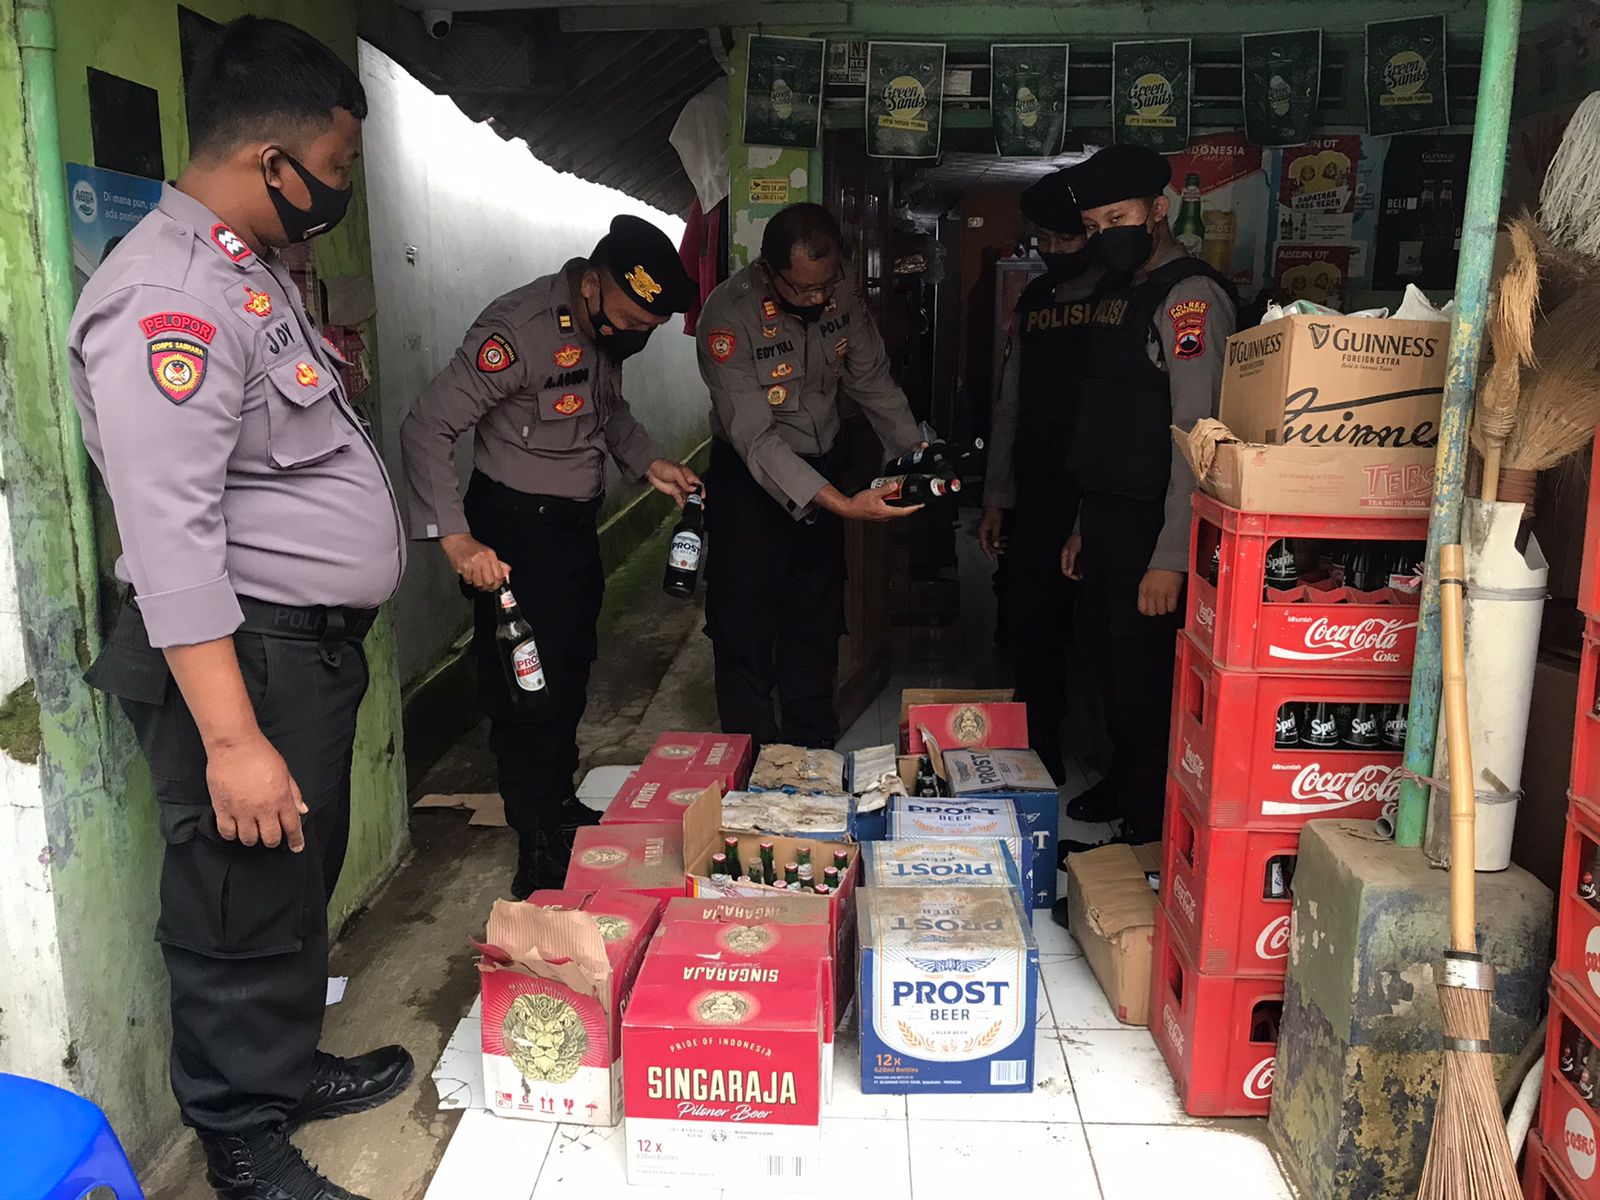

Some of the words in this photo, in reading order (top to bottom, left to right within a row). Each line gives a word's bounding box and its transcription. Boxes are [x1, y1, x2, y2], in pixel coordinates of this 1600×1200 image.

[1381, 60, 1420, 79] Green
[1386, 70, 1431, 88] Sands
[882, 86, 918, 100] Green
[1127, 83, 1165, 100] Green
[1133, 91, 1175, 110] Sands
[887, 94, 928, 112] Sands
[103, 191, 112, 201] Di
[113, 196, 131, 206] mana
[105, 208, 118, 219] ada
[145, 315, 210, 338] PELOPOR
[1026, 303, 1091, 332] POLISI
[757, 344, 776, 360] EDY
[1237, 332, 1283, 364] GUINNESS
[1332, 328, 1437, 358] GUINNESS
[1342, 354, 1374, 364] FOREIGN
[1376, 356, 1401, 366] EXTRA
[671, 542, 701, 556] PROST
[272, 608, 322, 632] POL
[1304, 617, 1403, 651] Coca-Cola
[1372, 650, 1400, 663] Coke
[970, 754, 1000, 785] PROST
[907, 804, 999, 816] PROST
[938, 814, 972, 822] BEER
[890, 863, 993, 878] PROST
[889, 916, 1004, 932] PROST
[682, 965, 780, 983] SINGARAJA
[891, 980, 1011, 1007] PROST
[930, 1008, 970, 1021] BEER
[669, 1039, 698, 1053] PRIDE
[702, 1037, 714, 1045] OF
[718, 1038, 772, 1057] INDONESIA
[876, 1054, 893, 1066] 12
[894, 1057, 901, 1066] x
[647, 1066, 798, 1105] SINGARAJA
[676, 1101, 730, 1119] Pilsner
[730, 1104, 773, 1122] Beer
[637, 1139, 651, 1152] 12
[655, 1142, 662, 1152] x
